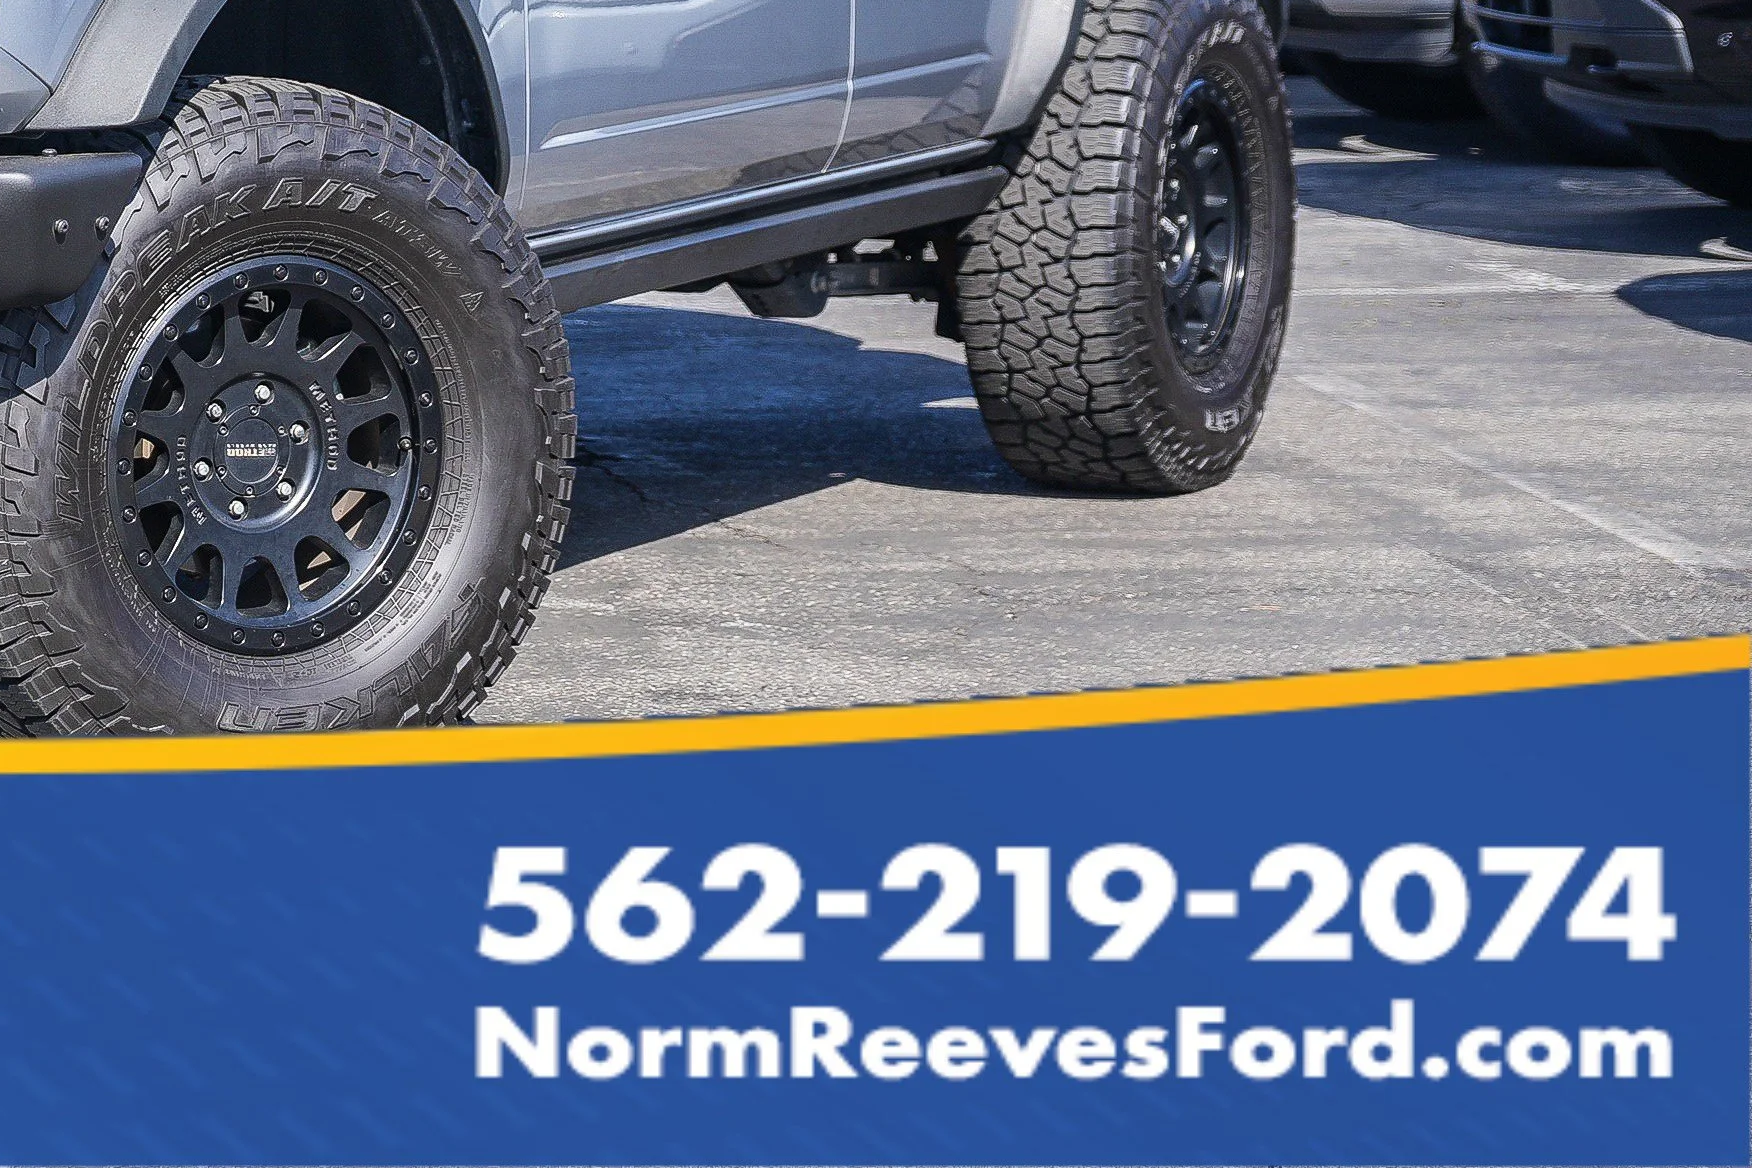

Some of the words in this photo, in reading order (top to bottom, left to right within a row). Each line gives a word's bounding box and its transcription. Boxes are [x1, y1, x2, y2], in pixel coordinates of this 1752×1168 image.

[53, 184, 257, 523] WILDPEAK
[262, 177, 381, 212] A/T
[175, 435, 208, 526] METHOD
[308, 380, 340, 471] METHOD
[216, 576, 487, 732] FALKEN
